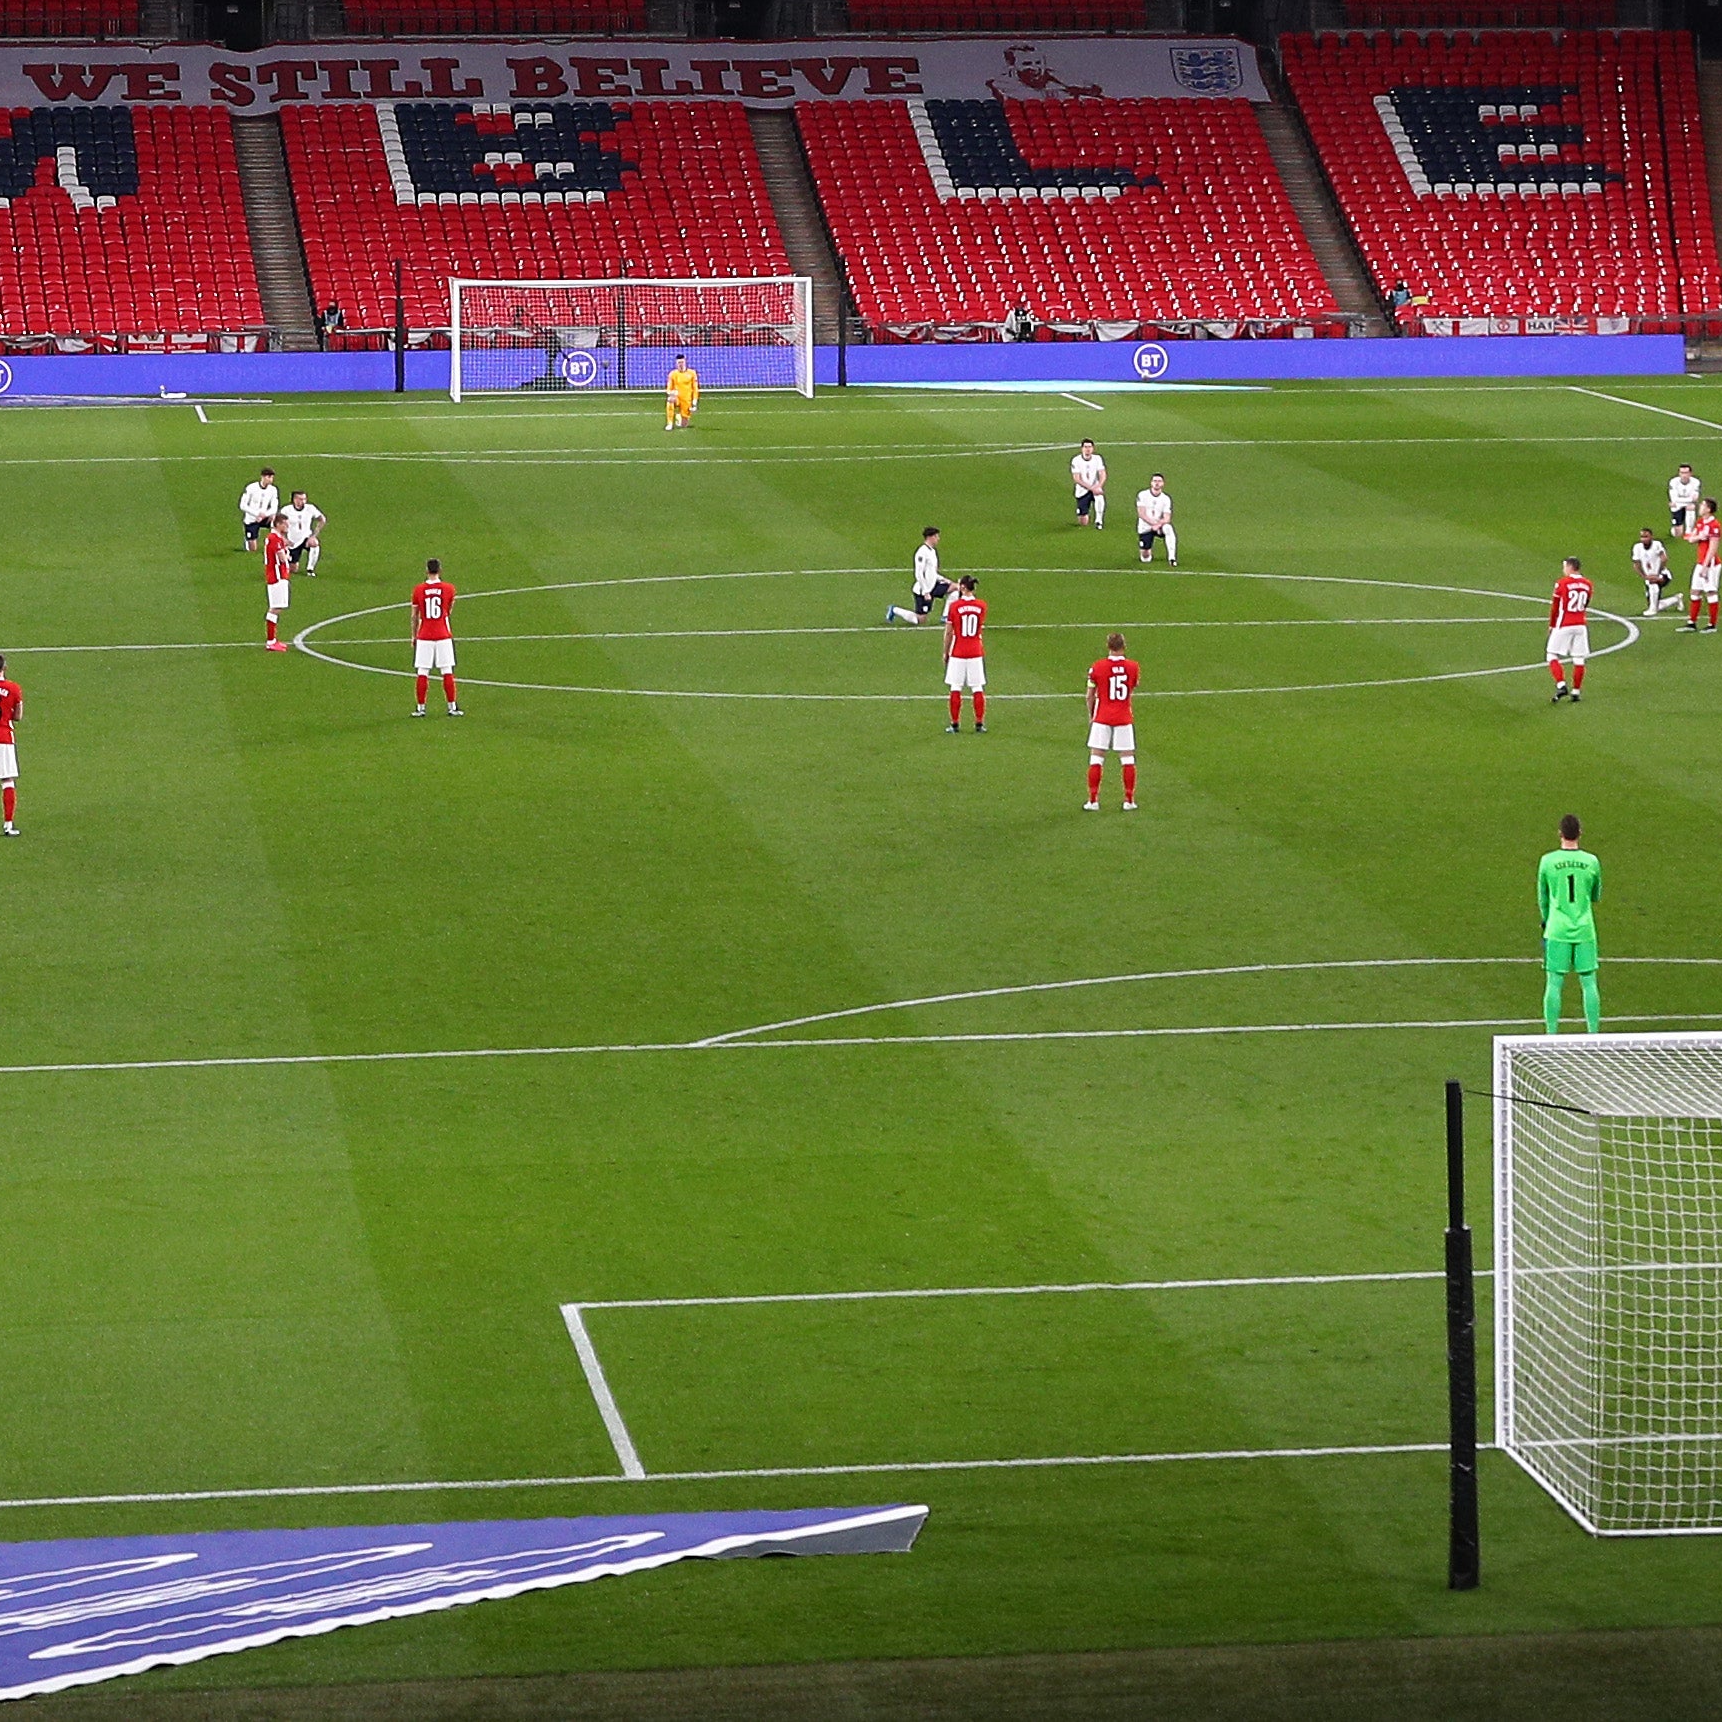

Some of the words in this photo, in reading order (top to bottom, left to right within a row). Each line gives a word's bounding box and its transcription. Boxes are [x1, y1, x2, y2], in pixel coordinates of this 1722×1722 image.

[22, 63, 182, 101] WE
[209, 58, 485, 106] STILL
[506, 56, 924, 97] BELIEVE
[570, 361, 589, 375] BT
[1141, 354, 1160, 367] BT
[425, 596, 442, 619] 16
[1568, 590, 1588, 613] 20
[959, 613, 978, 637] 10
[1110, 675, 1127, 700] 15
[1567, 874, 1575, 903] 1
